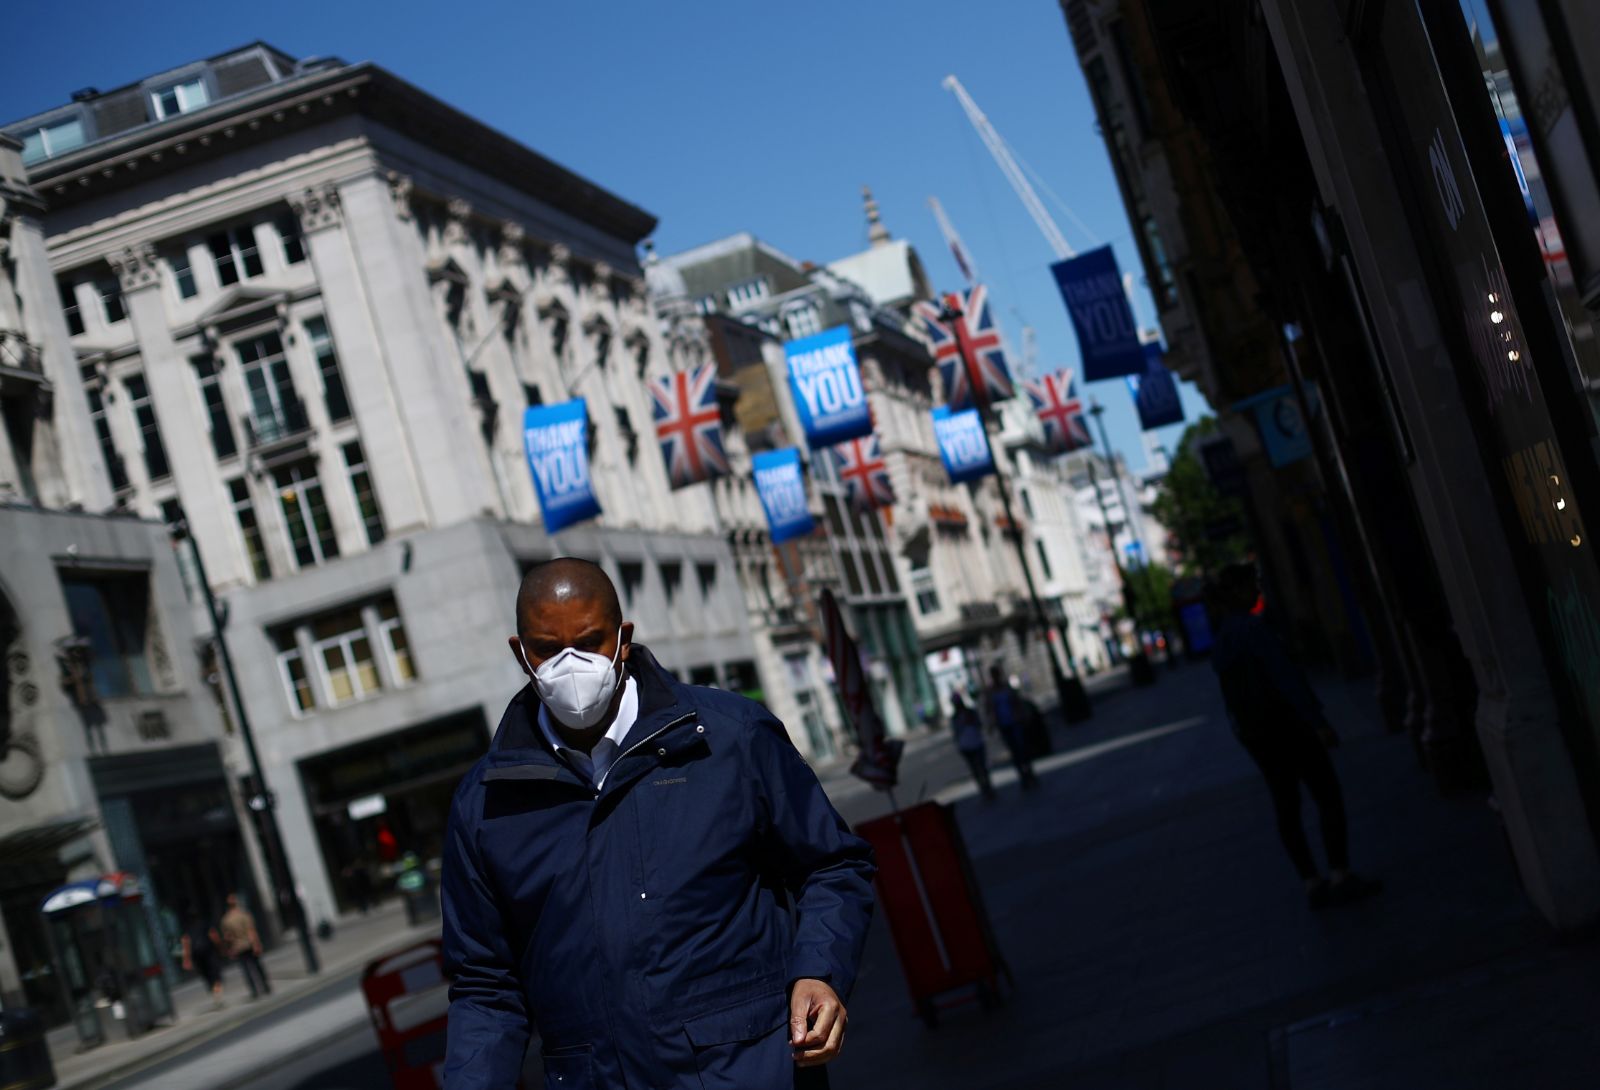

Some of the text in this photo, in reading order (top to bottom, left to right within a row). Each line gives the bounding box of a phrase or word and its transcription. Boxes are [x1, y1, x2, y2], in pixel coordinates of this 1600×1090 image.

[788, 341, 855, 377] THANK
[797, 363, 864, 417] YOU
[525, 417, 584, 454] THANK
[940, 427, 990, 465] YOU
[530, 444, 589, 496] YOU
[761, 480, 809, 519] YOU
